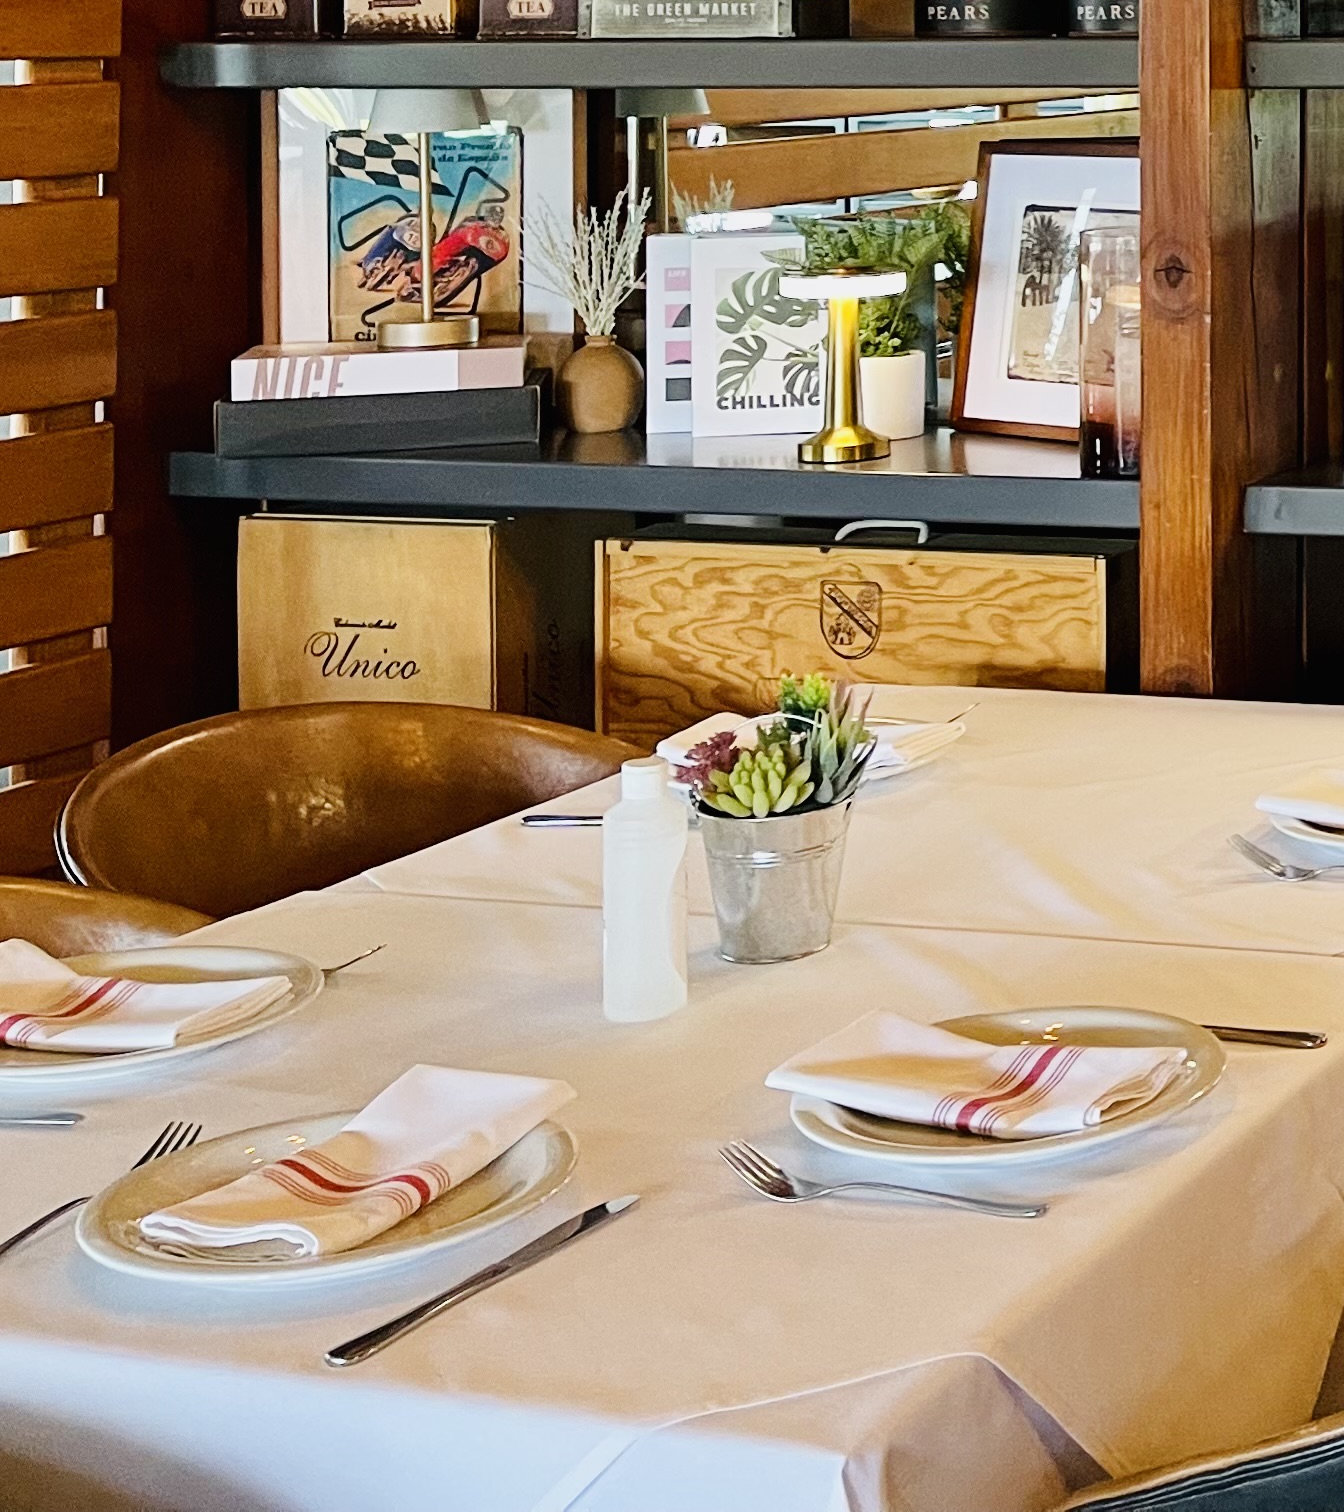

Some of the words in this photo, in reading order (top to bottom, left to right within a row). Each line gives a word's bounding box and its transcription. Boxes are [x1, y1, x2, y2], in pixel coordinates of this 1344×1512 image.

[250, 0, 279, 17] TEA
[517, 0, 547, 15] TEA
[615, 3, 641, 17] THE
[646, 2, 692, 17] GREEN
[699, 1, 757, 17] MARKET
[927, 4, 991, 22] PEARS
[1077, 4, 1135, 21] PEARS
[716, 393, 822, 412] CHILLING
